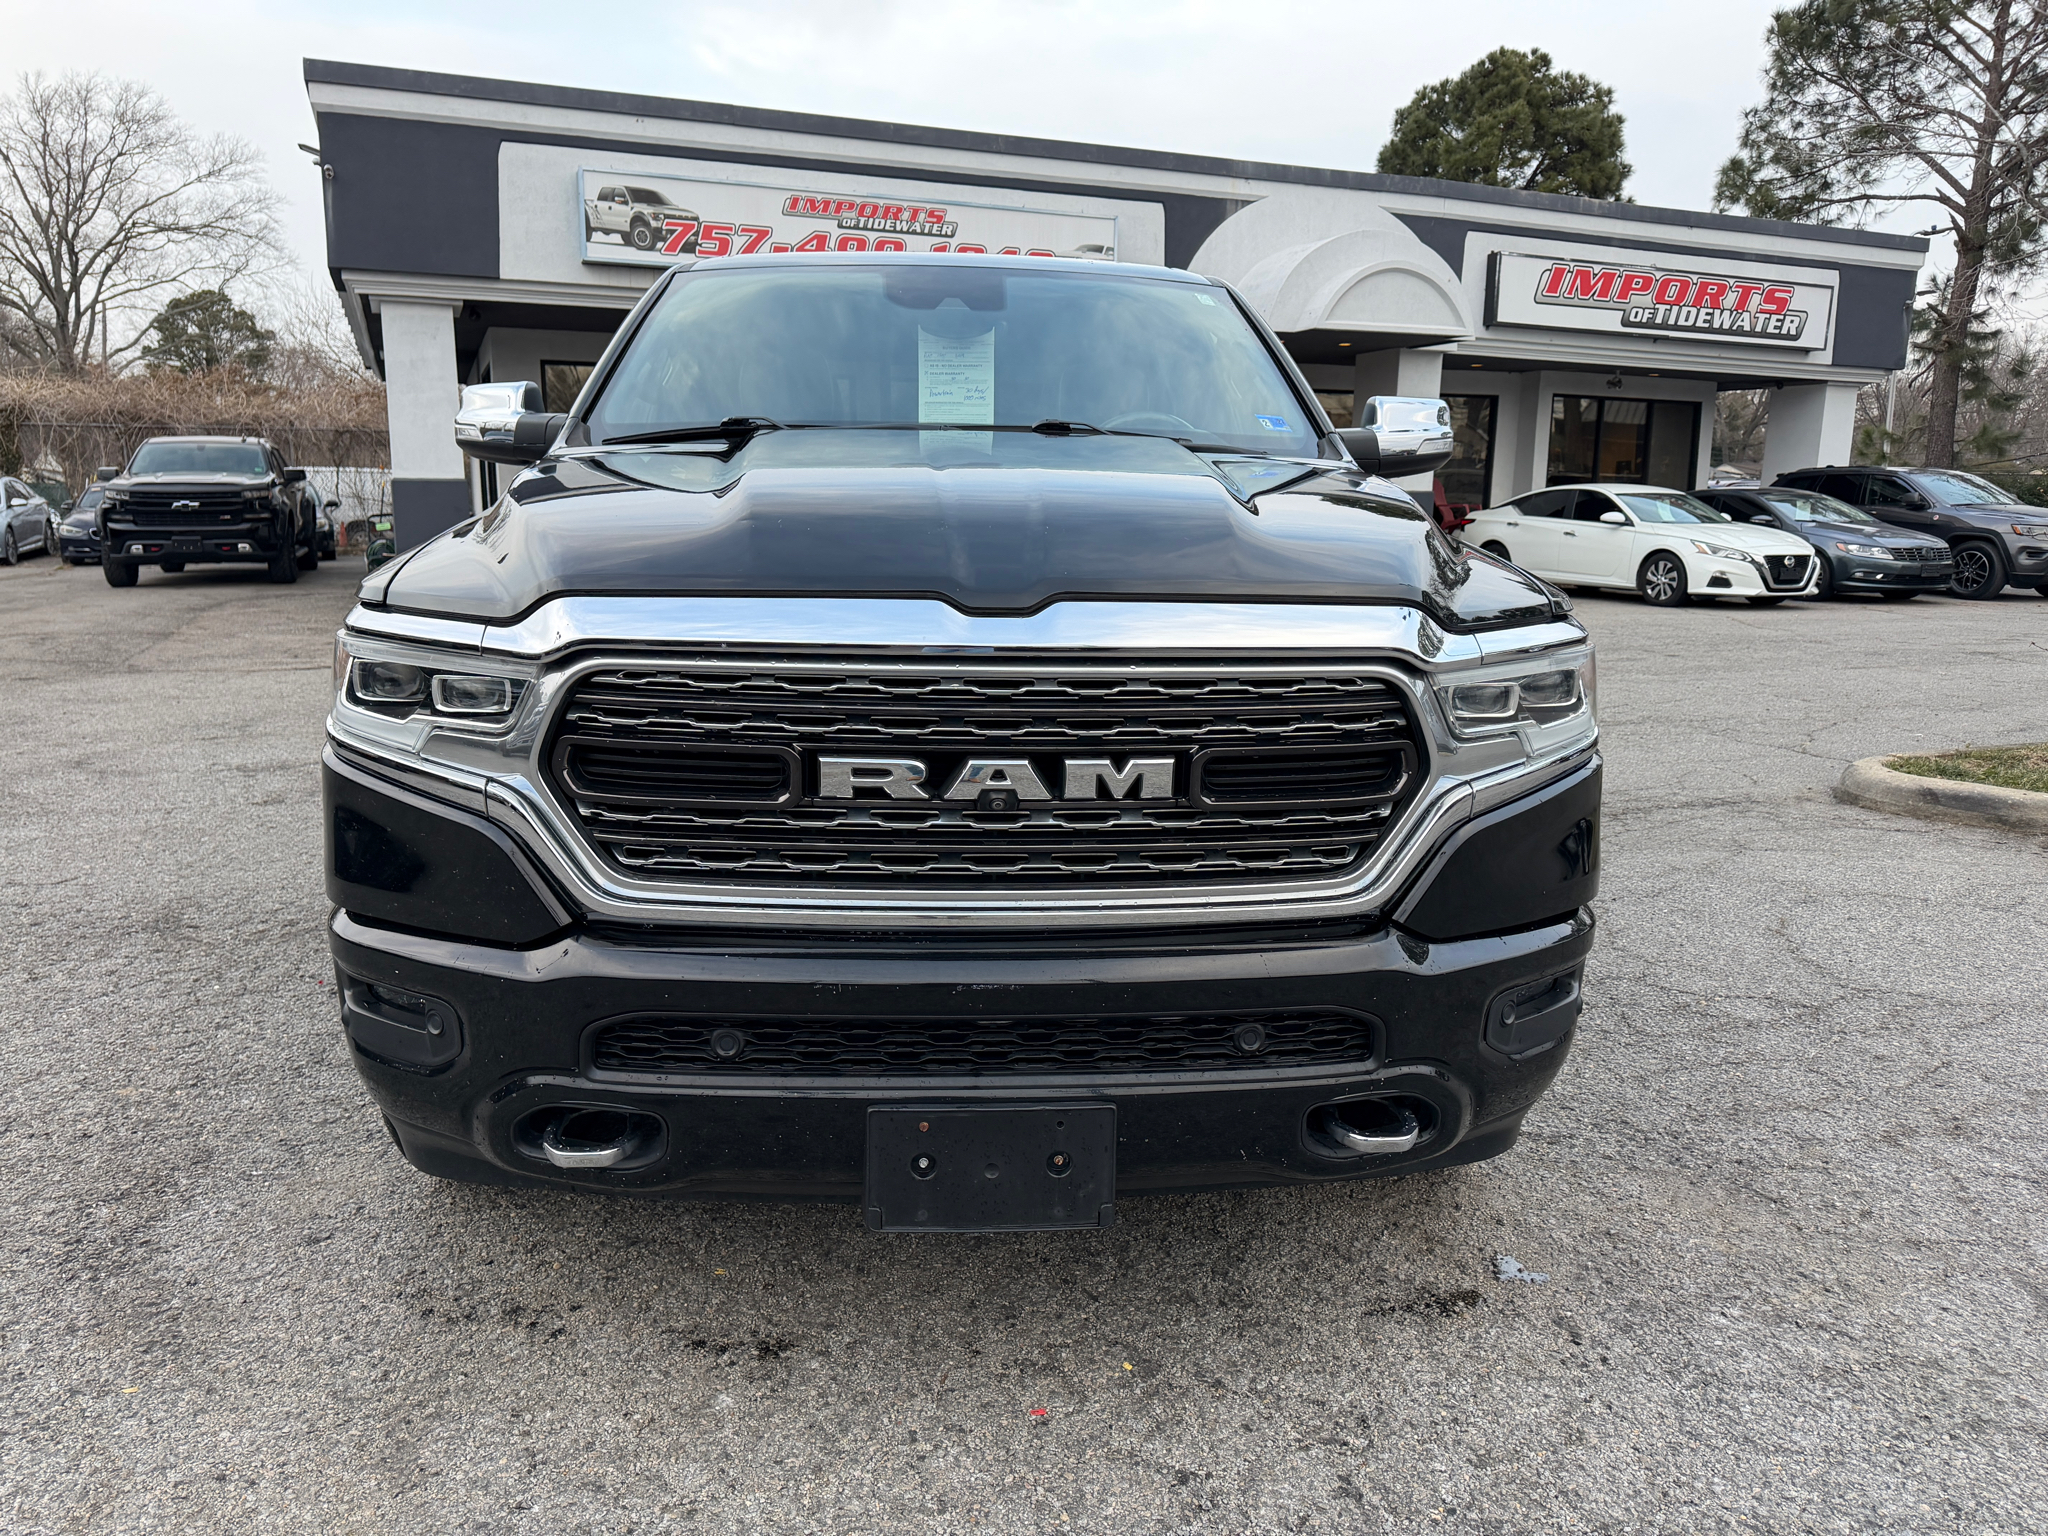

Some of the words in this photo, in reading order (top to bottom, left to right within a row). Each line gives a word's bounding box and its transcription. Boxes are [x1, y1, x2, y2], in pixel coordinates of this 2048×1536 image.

[788, 196, 947, 224] IMPORTS
[842, 218, 858, 228] OF
[857, 216, 954, 236] TIDEWATER
[1543, 264, 1795, 315] IMPORTS
[1629, 307, 1654, 324] OF
[1653, 304, 1801, 336] TIDEWATER
[818, 756, 1176, 801] RAM
